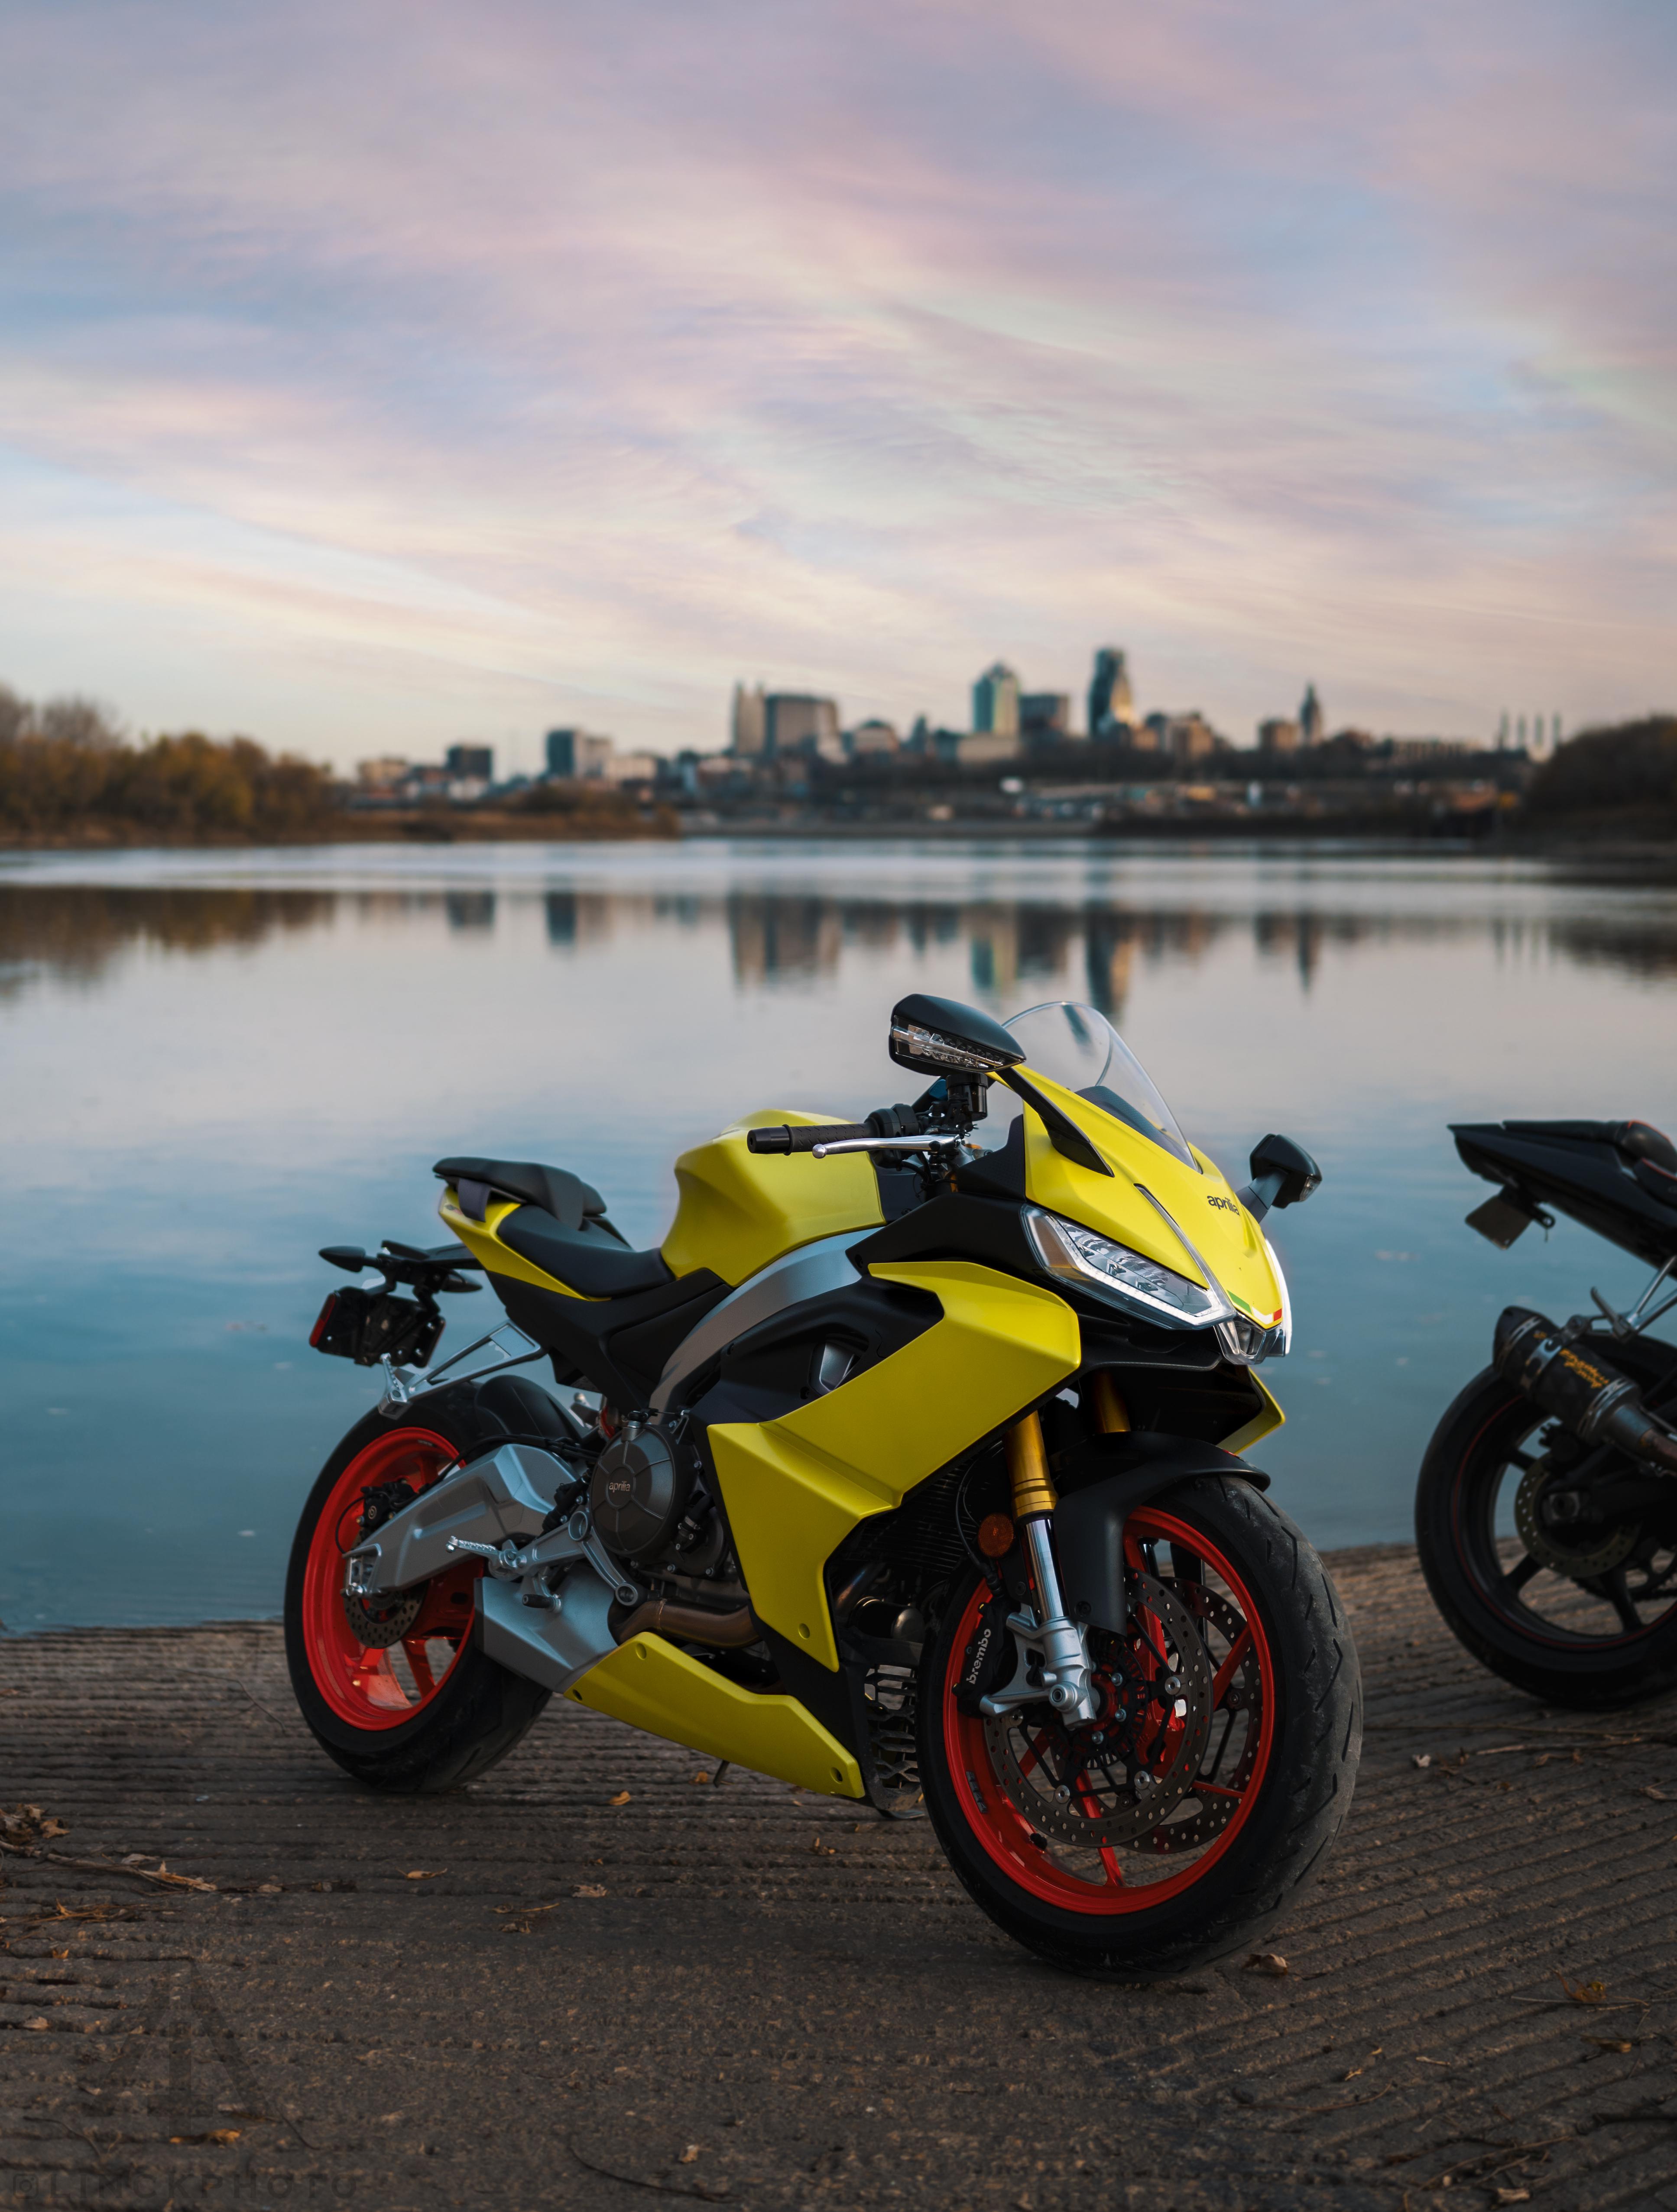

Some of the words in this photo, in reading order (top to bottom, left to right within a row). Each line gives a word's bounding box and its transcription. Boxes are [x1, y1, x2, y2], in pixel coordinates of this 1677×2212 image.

[1207, 1195, 1239, 1216] aprilia
[609, 1480, 631, 1493] aprilia
[966, 1629, 991, 1684] brembo
